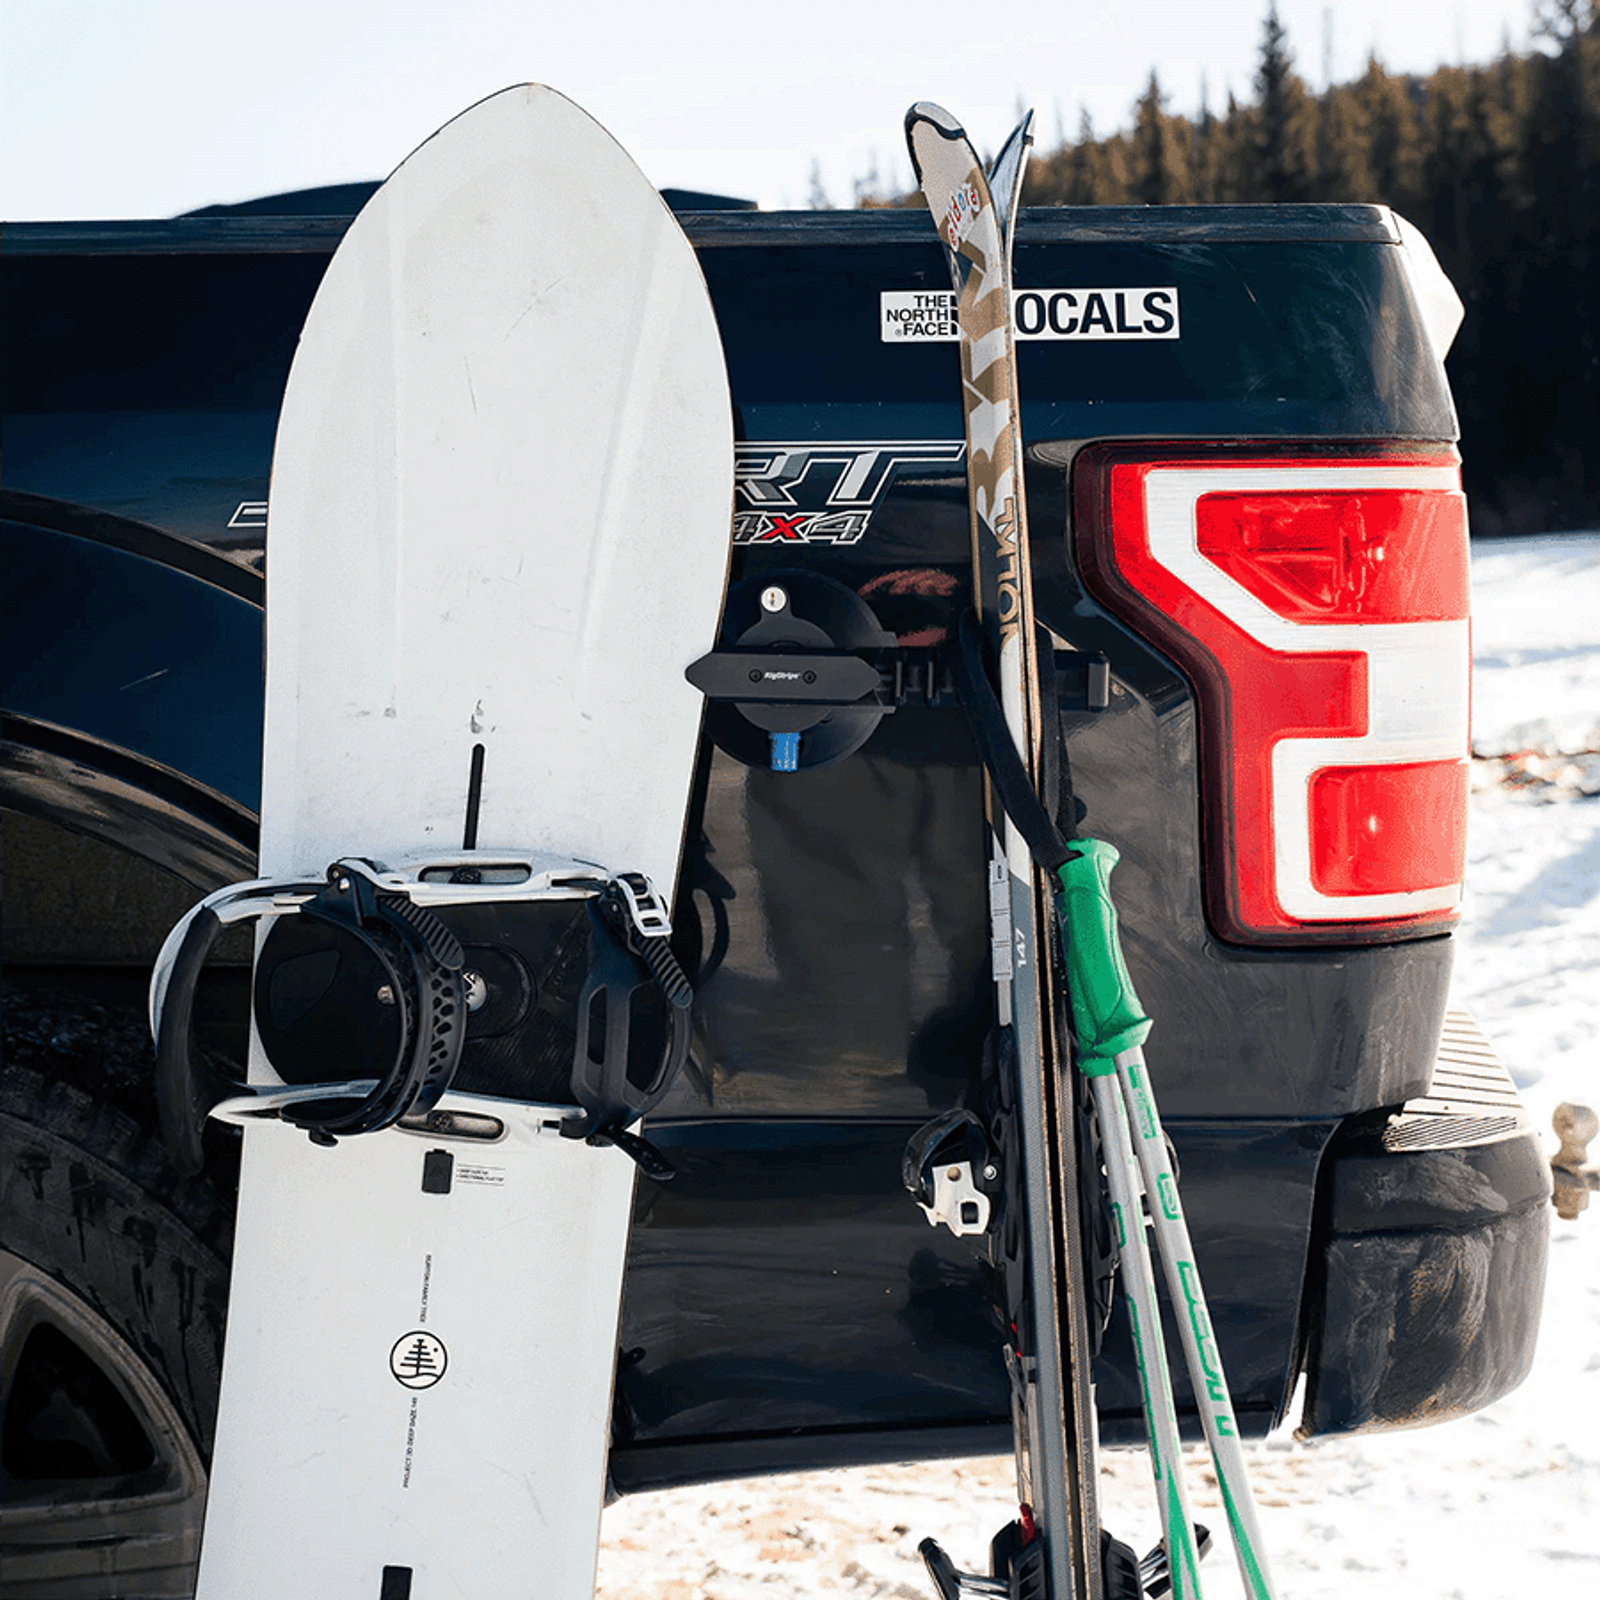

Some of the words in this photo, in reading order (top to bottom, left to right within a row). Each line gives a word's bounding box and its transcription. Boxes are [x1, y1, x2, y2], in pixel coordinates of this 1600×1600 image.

[913, 294, 948, 307] THE
[1014, 291, 1175, 335] OCALS
[886, 308, 949, 322] NORTH
[902, 322, 949, 335] FACE
[735, 440, 967, 506] RT
[1015, 927, 1027, 968] 147
